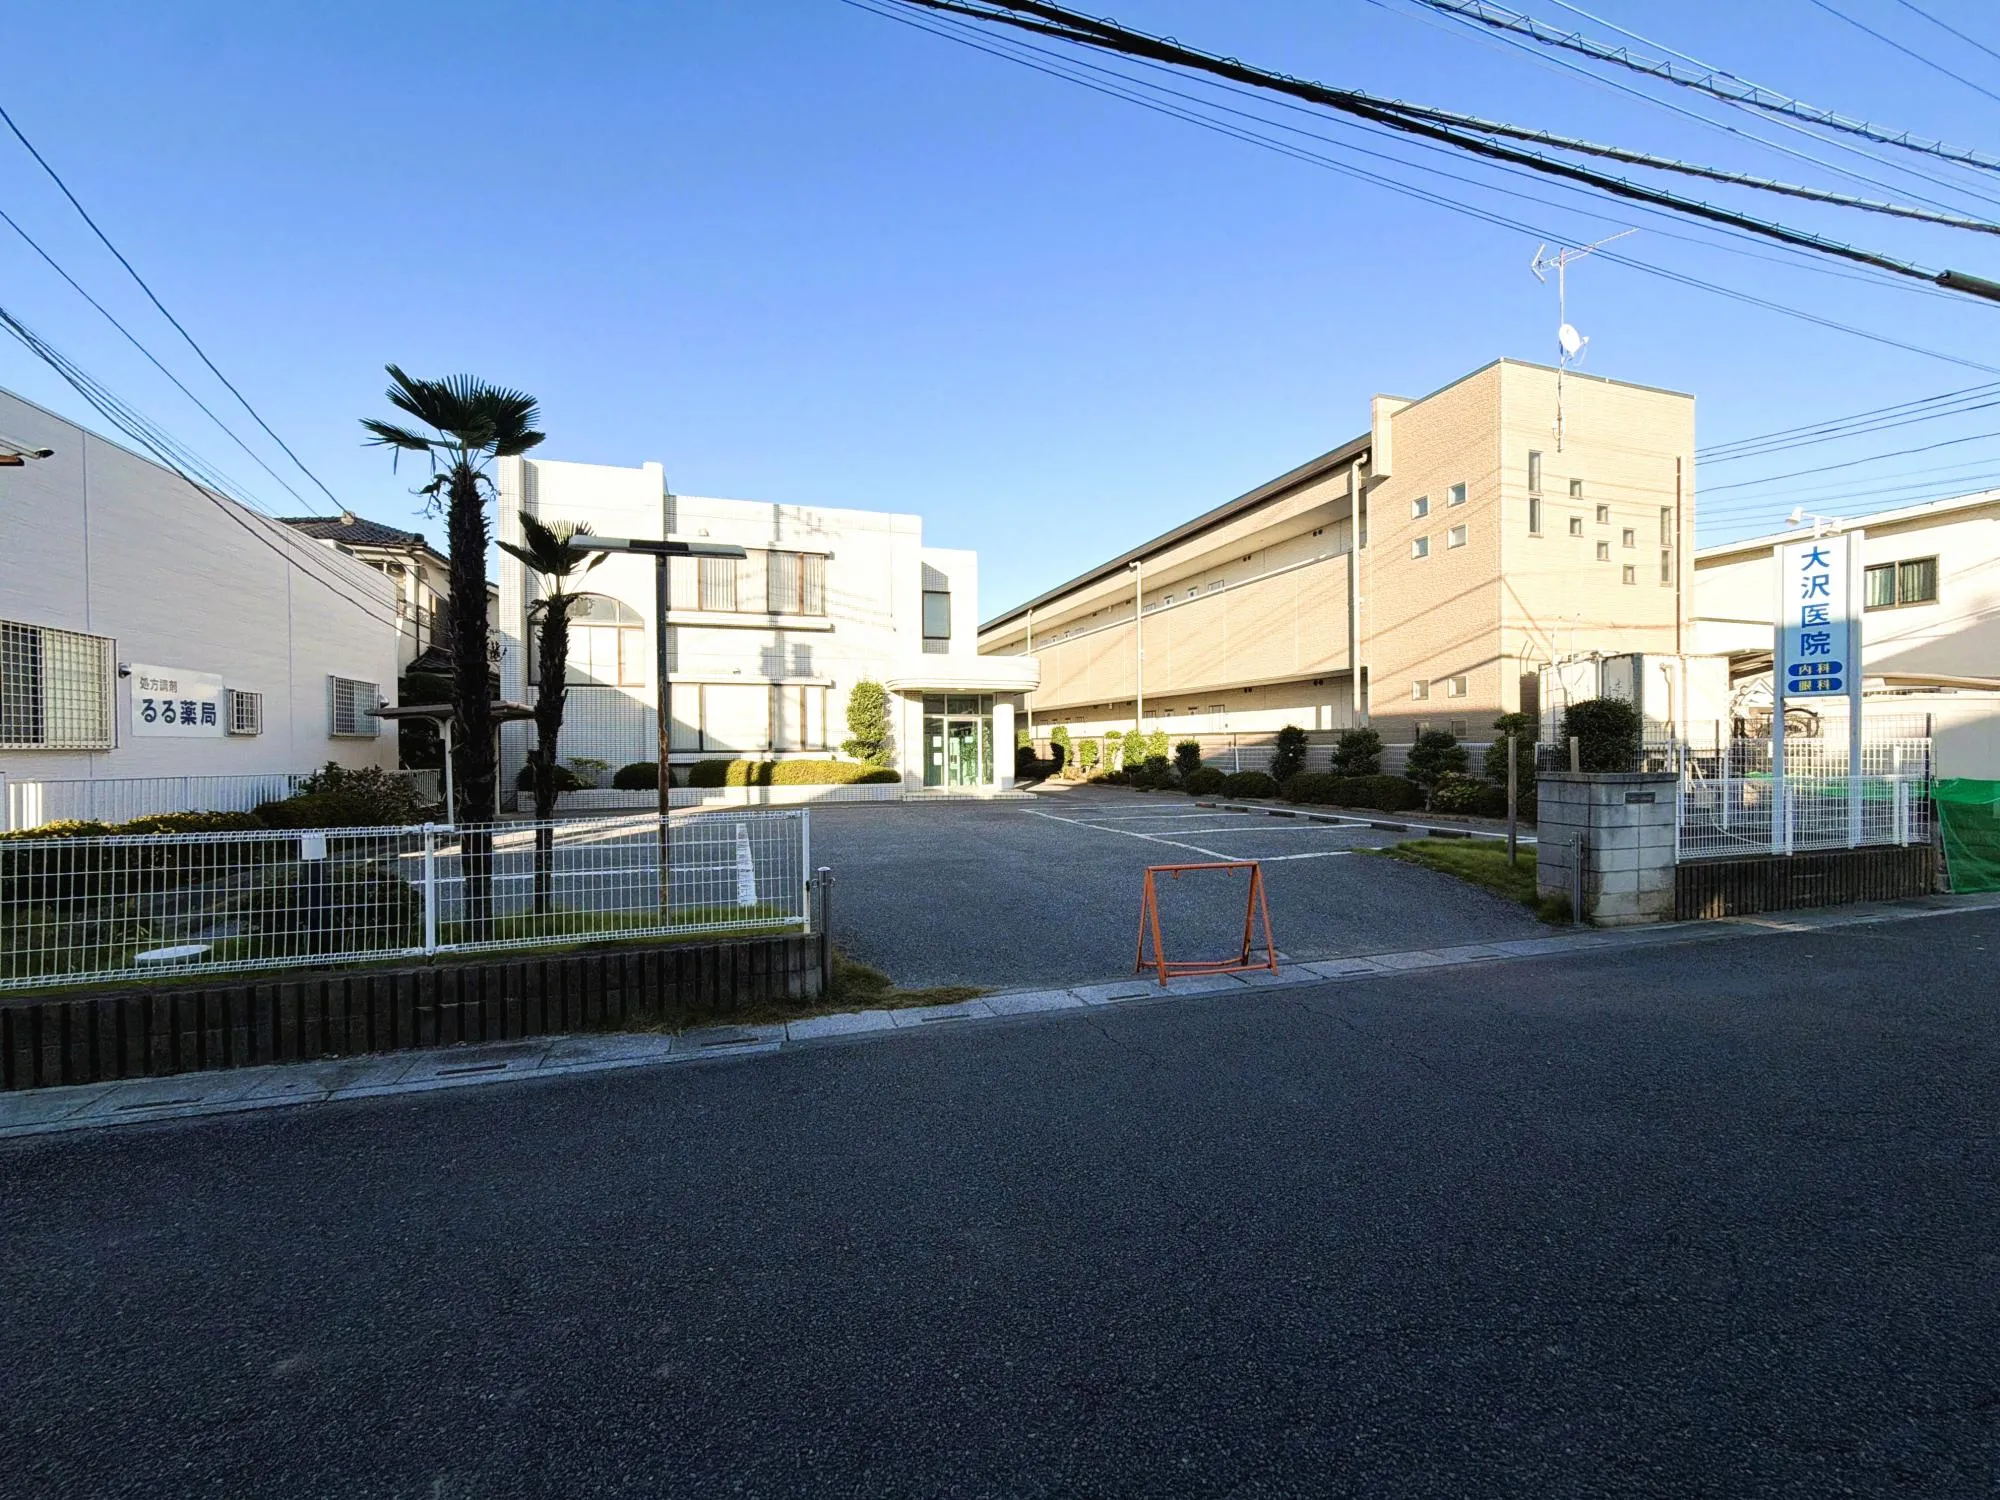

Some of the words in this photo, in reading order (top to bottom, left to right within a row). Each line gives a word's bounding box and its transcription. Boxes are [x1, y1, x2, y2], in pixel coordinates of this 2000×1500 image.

[1801, 546, 1831, 656] 大沢医院
[1798, 662, 1830, 676] 内科
[139, 677, 178, 693] 処方調剤
[1798, 679, 1830, 692] 眼科
[141, 698, 217, 726] るる薬局
